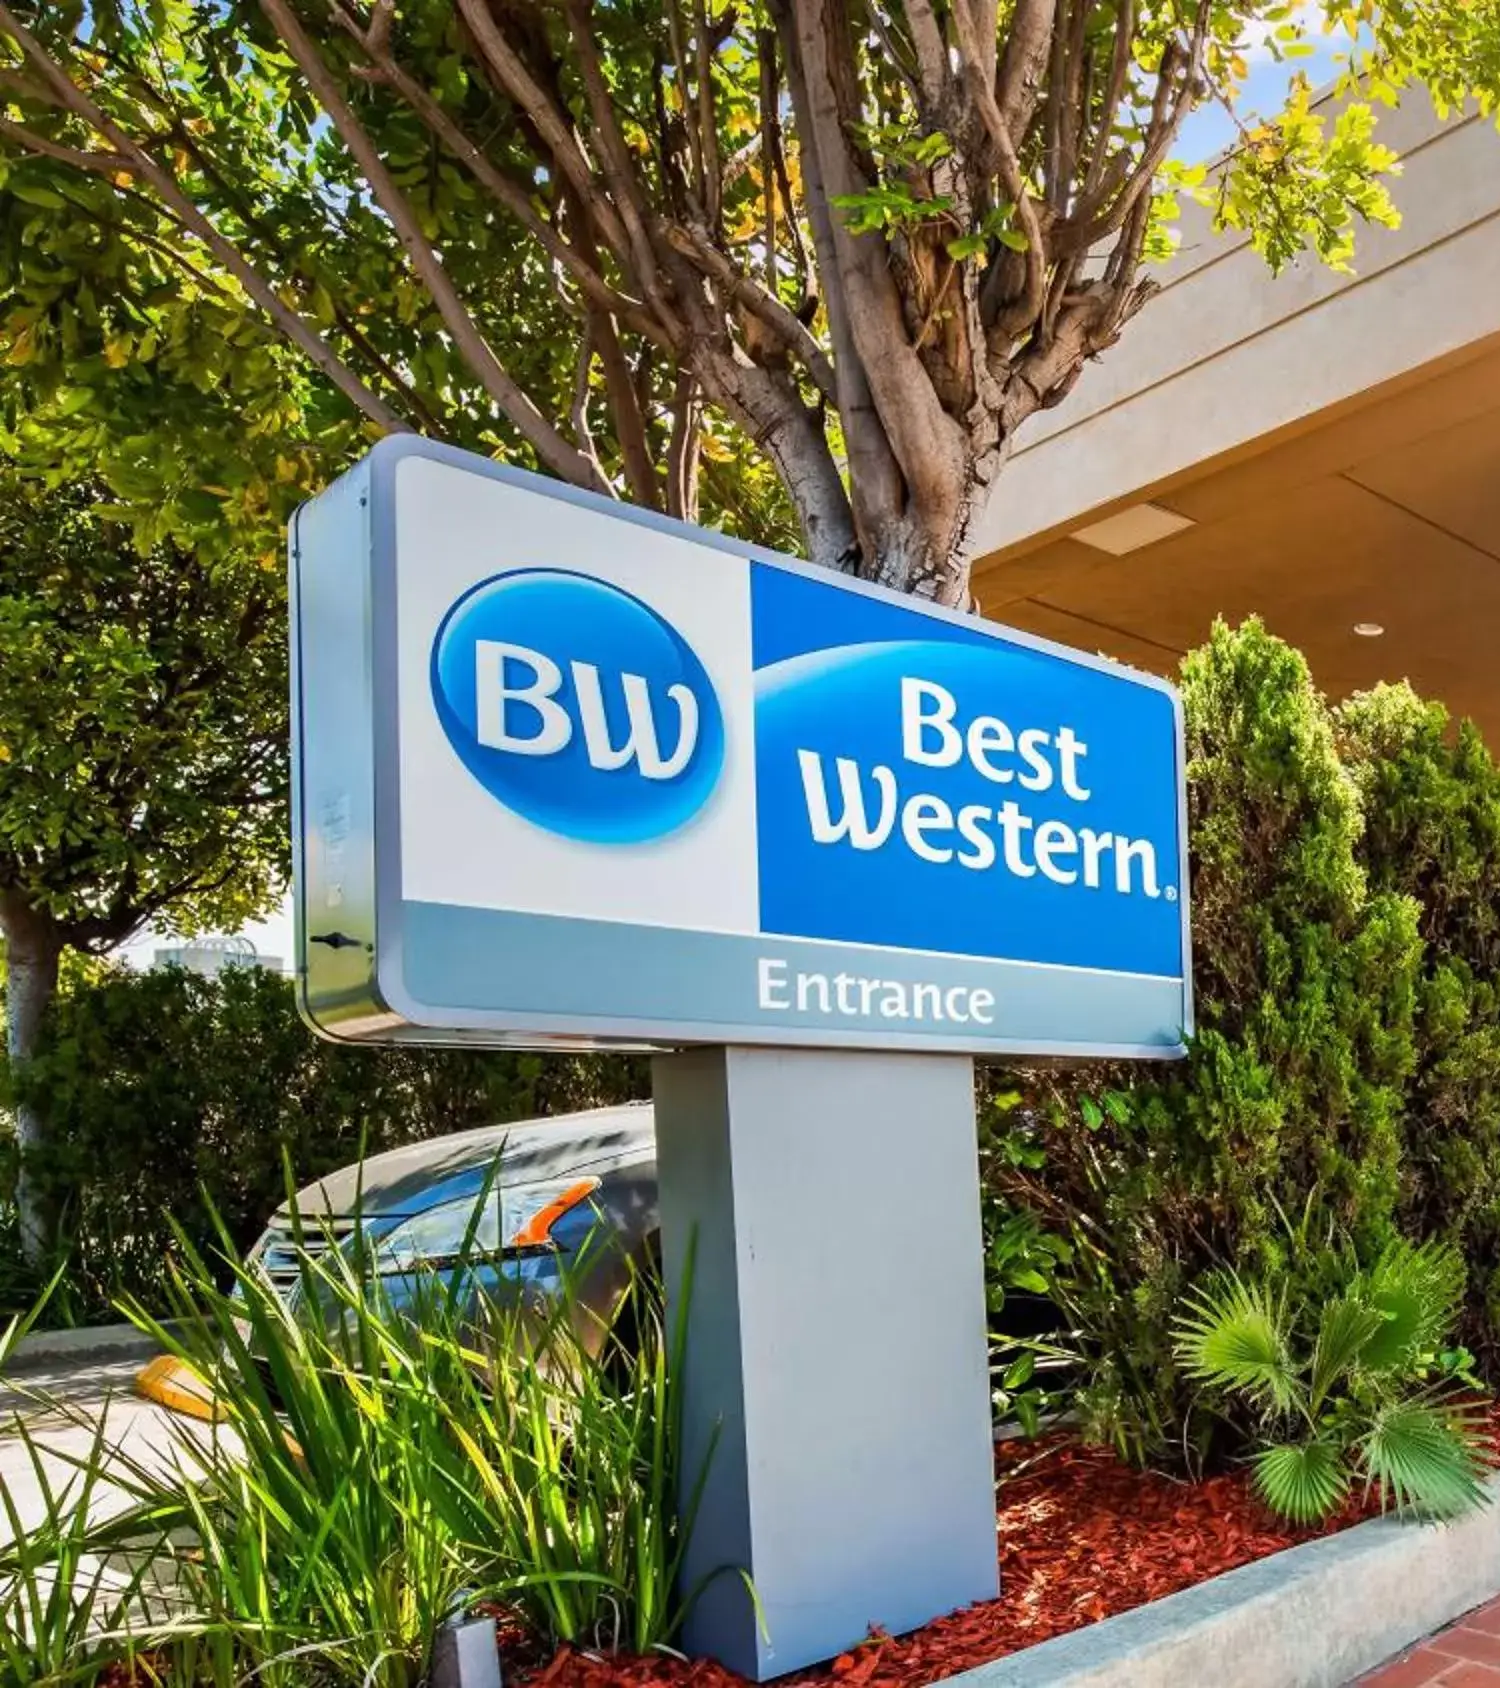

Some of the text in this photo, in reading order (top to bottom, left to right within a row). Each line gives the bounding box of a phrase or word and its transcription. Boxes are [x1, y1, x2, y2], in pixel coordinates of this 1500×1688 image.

[475, 639, 699, 781] BW
[900, 676, 1091, 801] Best
[757, 958, 995, 1024] Entrance
